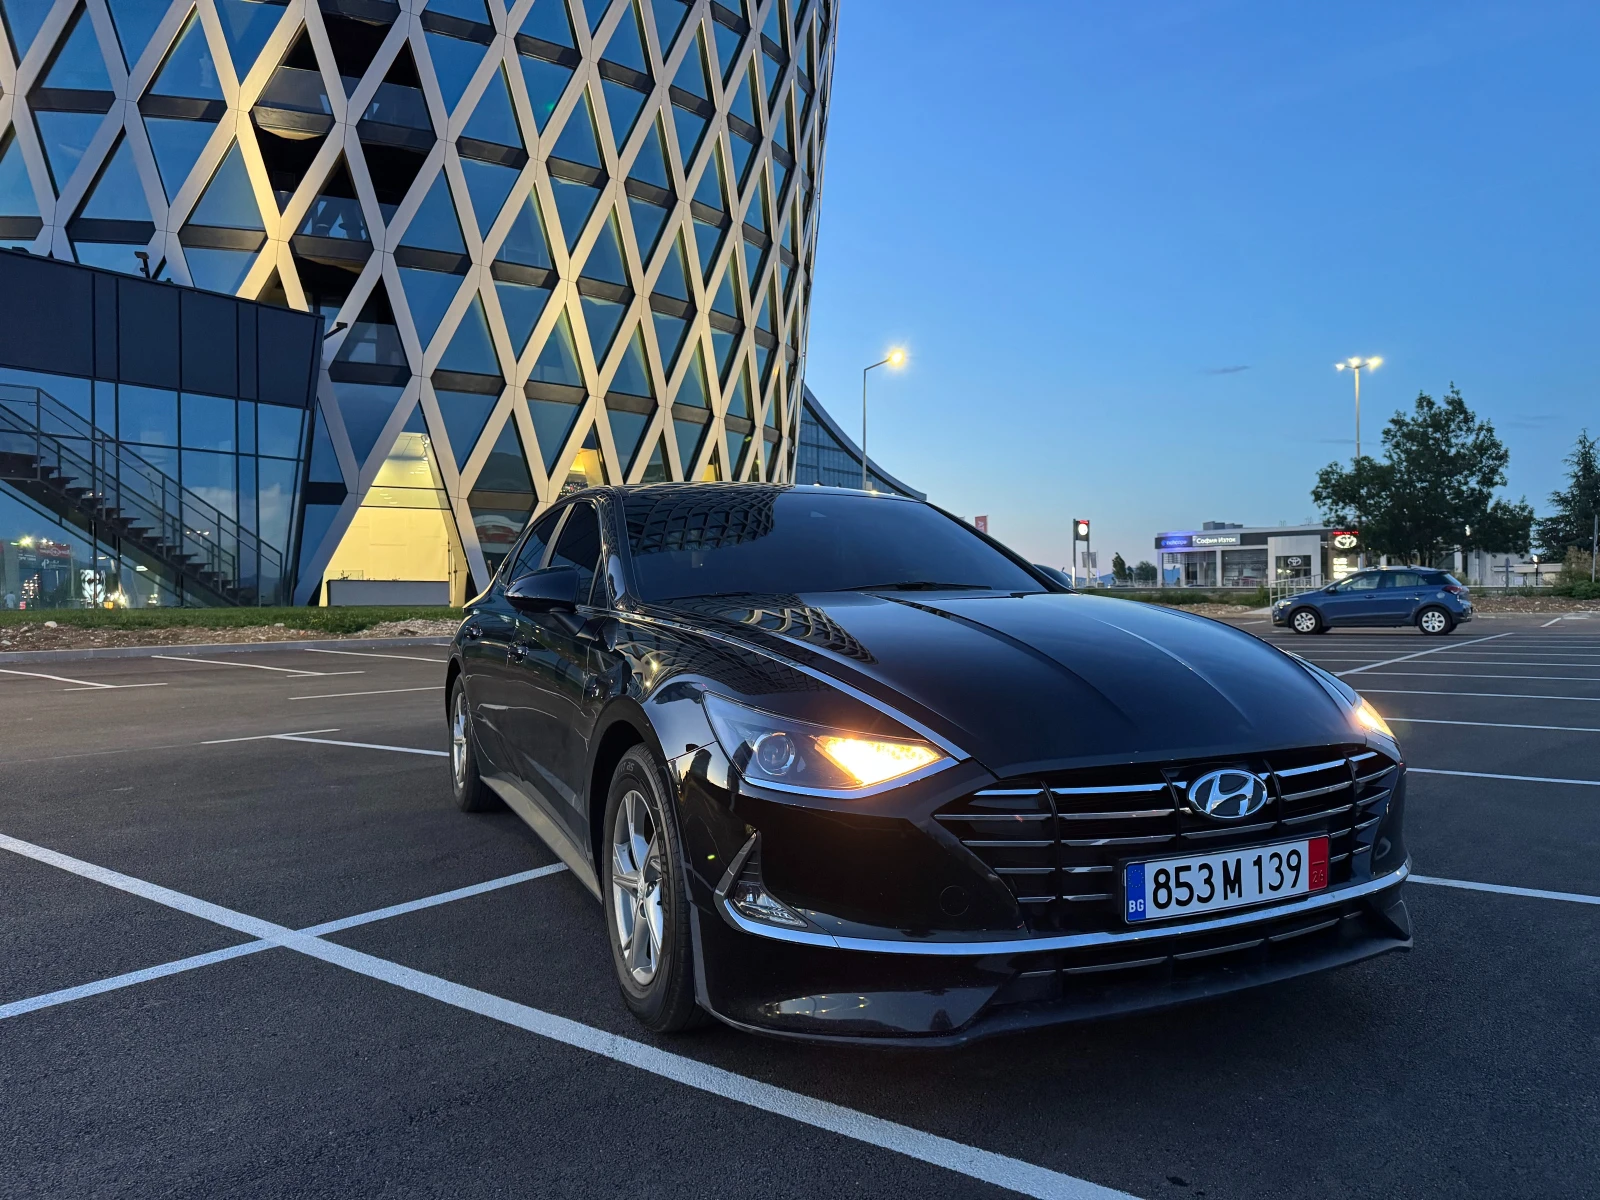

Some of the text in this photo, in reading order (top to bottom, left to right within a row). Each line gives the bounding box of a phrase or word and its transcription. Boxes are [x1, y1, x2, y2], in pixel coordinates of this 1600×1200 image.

[1196, 537, 1217, 545] София
[1152, 848, 1302, 910] 853 M 139
[1128, 898, 1145, 913] BG
